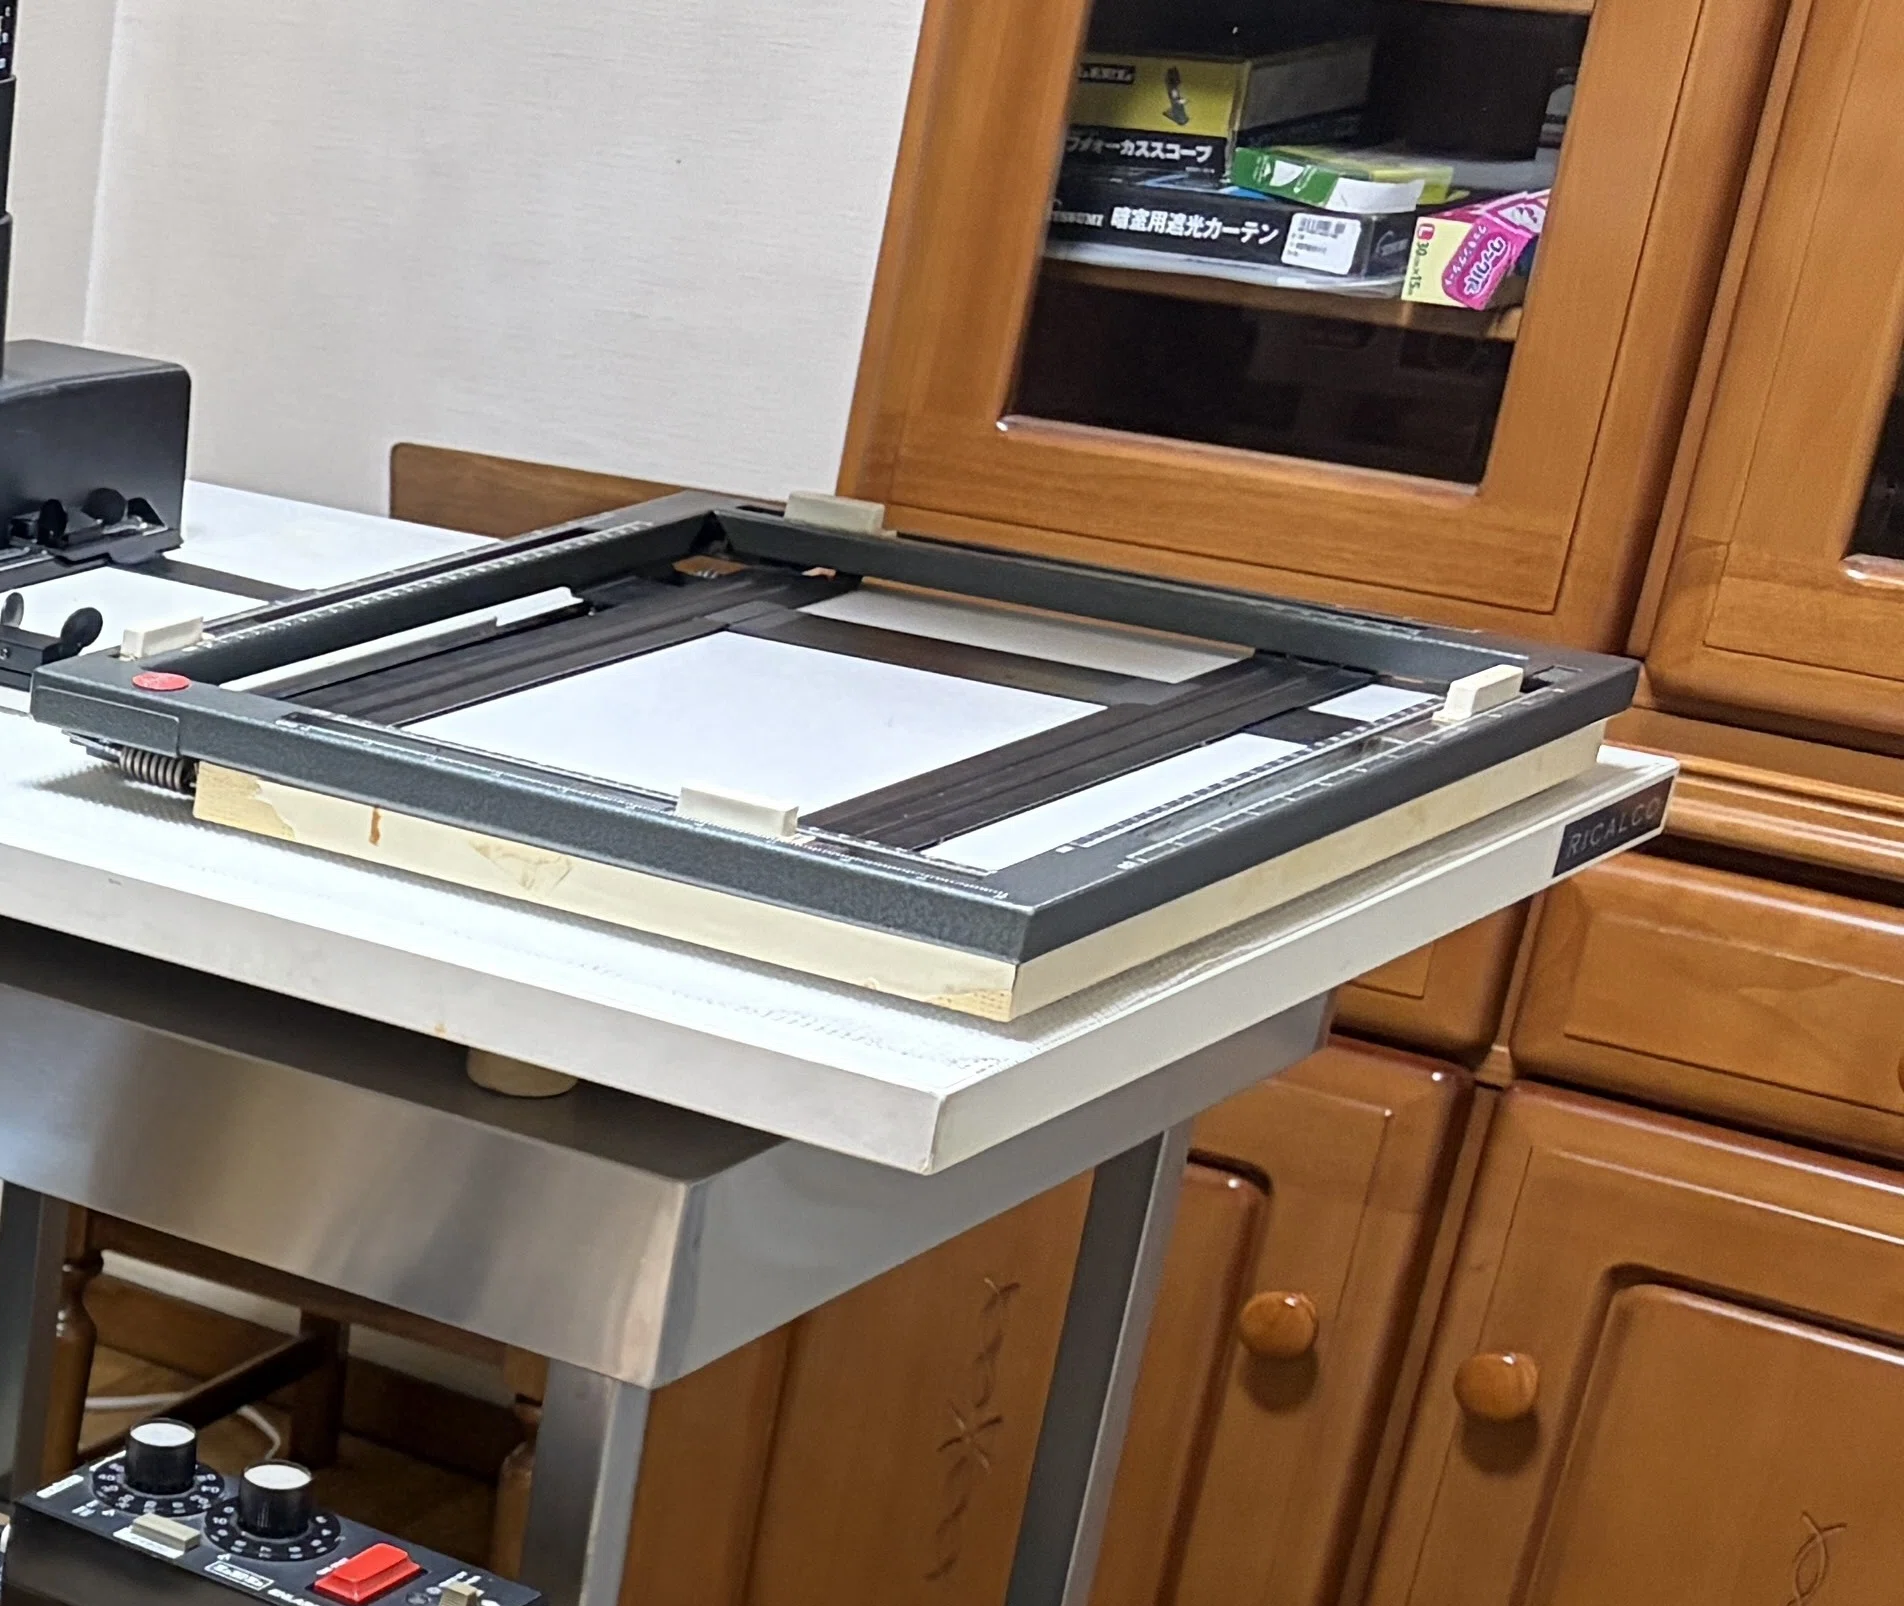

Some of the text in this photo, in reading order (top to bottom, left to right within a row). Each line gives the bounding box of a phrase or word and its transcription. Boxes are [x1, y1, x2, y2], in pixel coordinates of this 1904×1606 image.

[1110, 206, 1279, 245] 暗室用遮光カーテン
[1566, 797, 1662, 859] RICALCO
